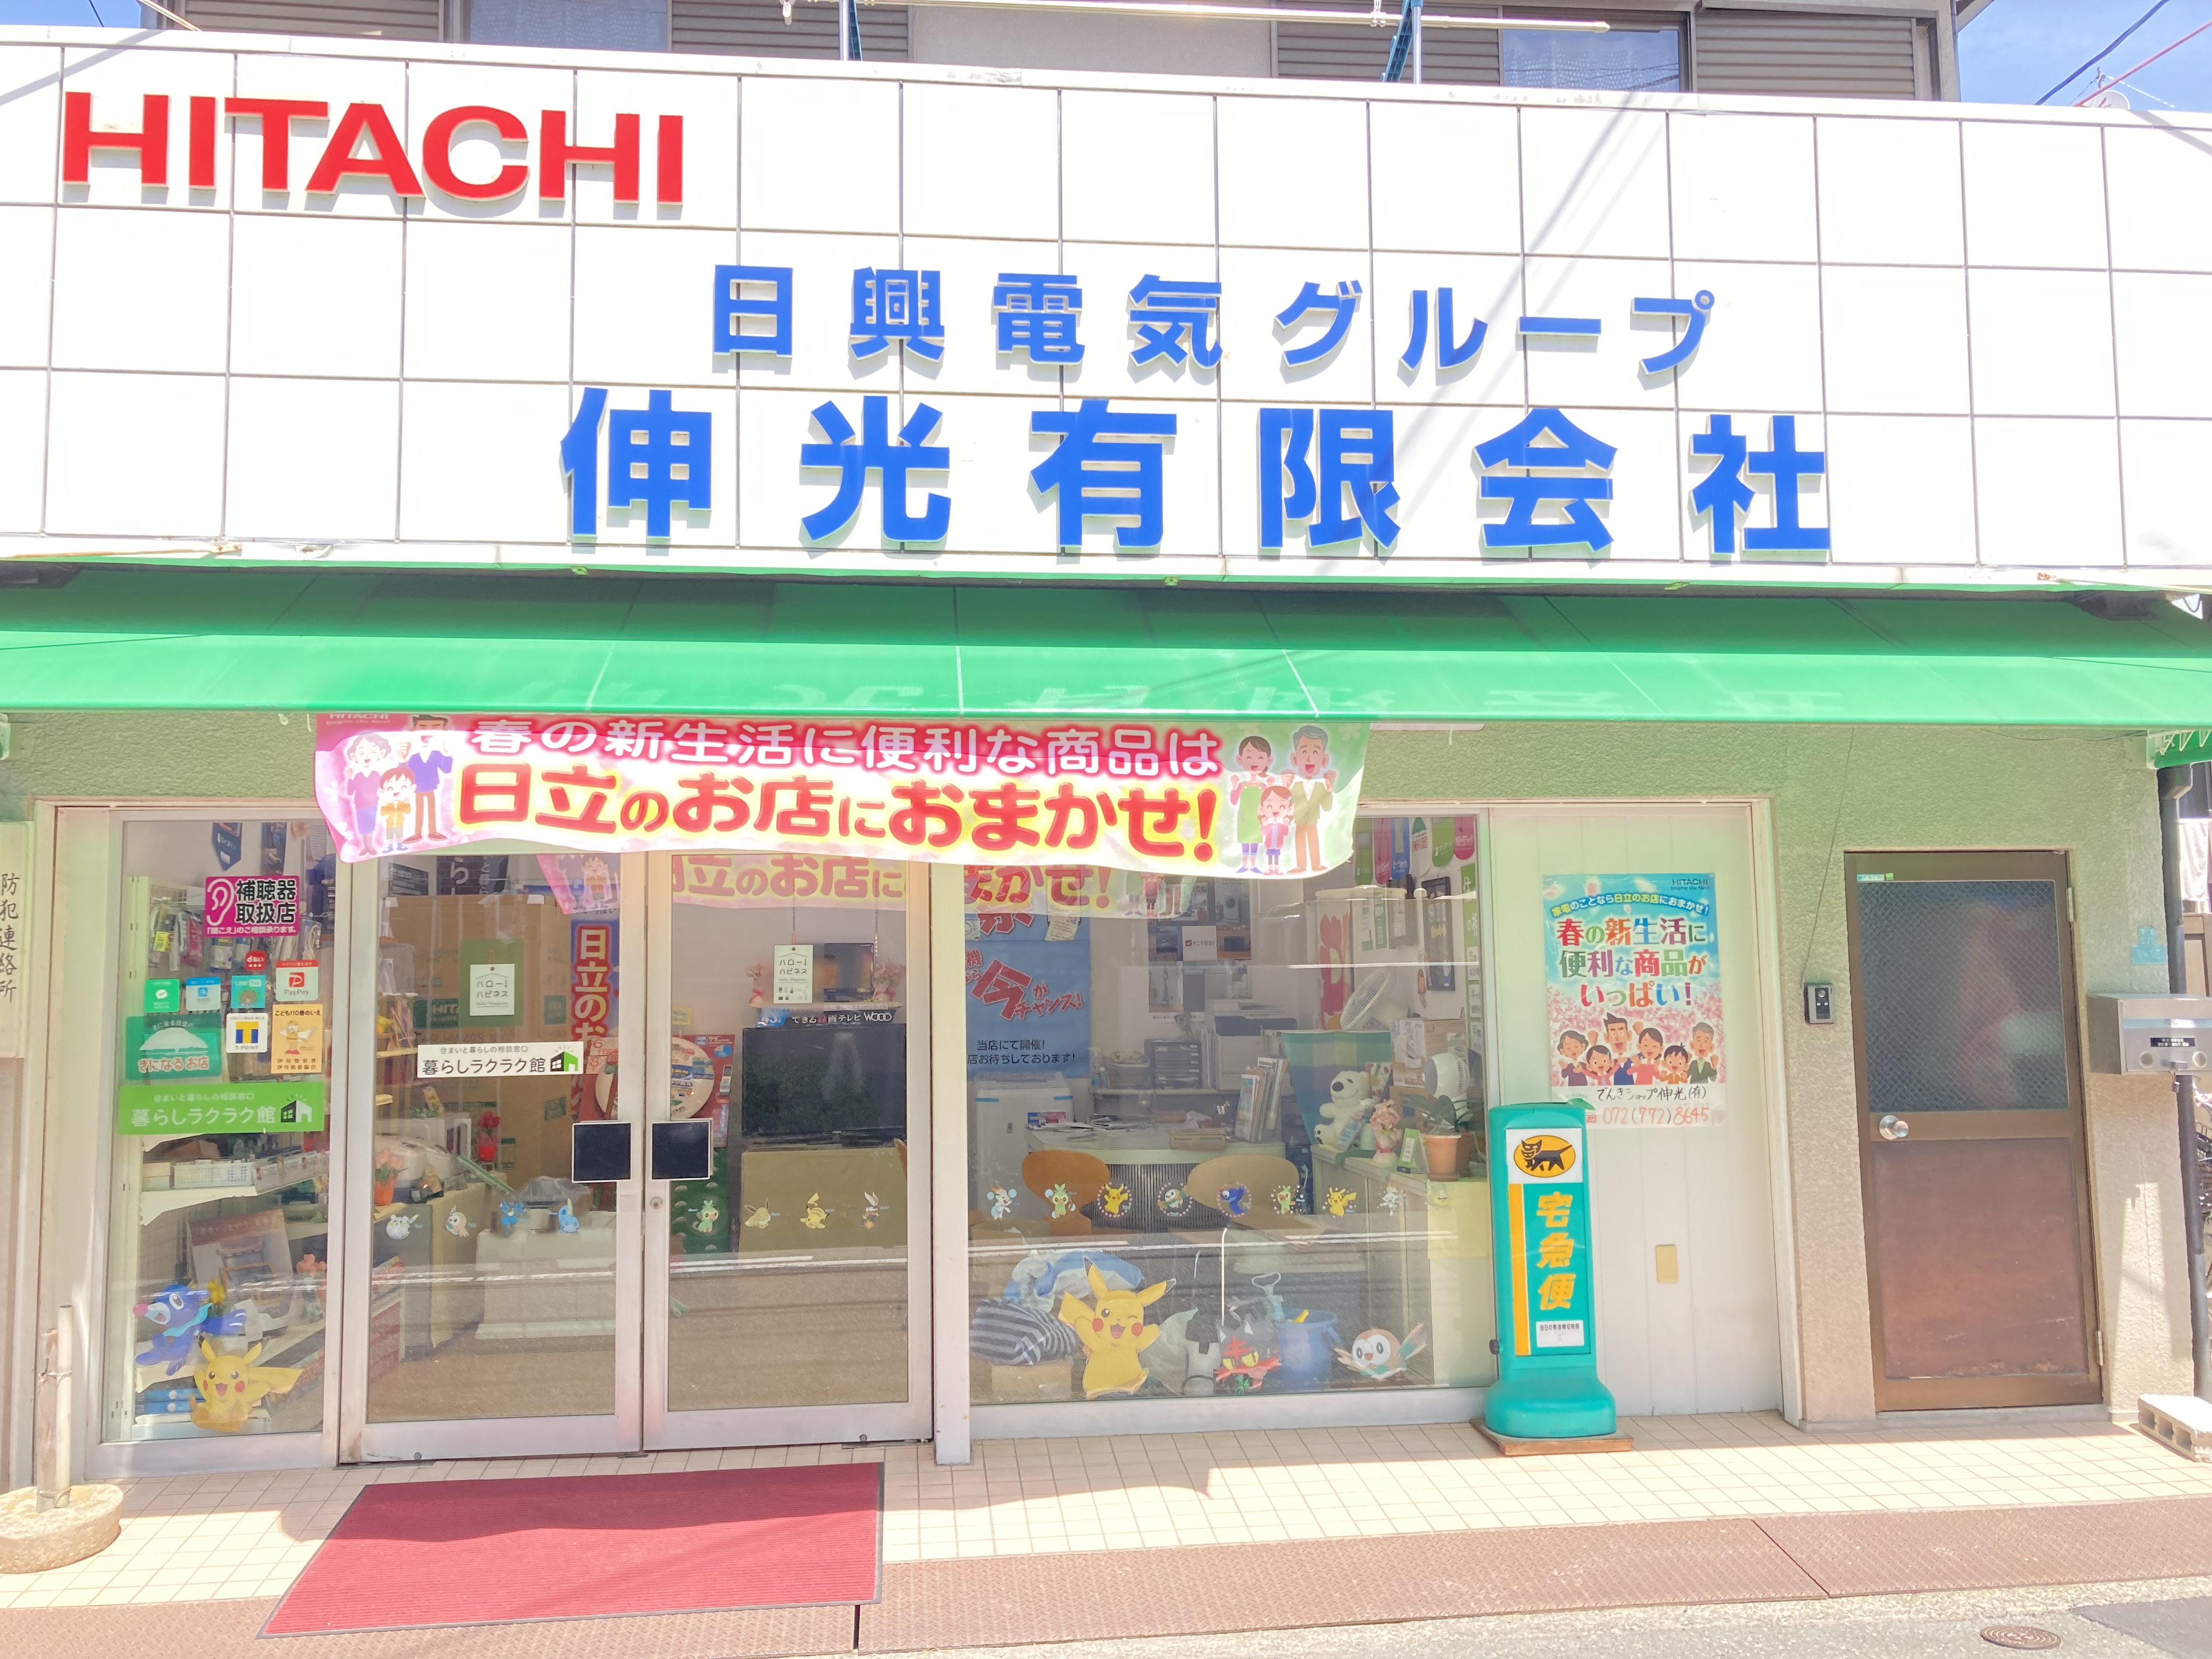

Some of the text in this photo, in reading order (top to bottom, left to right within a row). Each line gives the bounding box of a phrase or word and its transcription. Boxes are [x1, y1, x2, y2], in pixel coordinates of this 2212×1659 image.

[63, 92, 683, 205] HITACHI
[714, 264, 1715, 377] 日興電気グループ
[560, 387, 1831, 554] 伸光有限会社
[472, 719, 1219, 776] 春の新生活に便利な商品は
[459, 763, 1217, 862] 日立のお店におまかせ!
[235, 879, 296, 901] 補聴器
[235, 902, 296, 924] 取扱店
[1551, 893, 1709, 917] 家電のことなら日立のお店におまかせ!
[1556, 917, 1706, 946] 春の新生活に
[1559, 948, 1707, 979] 便利な商品が
[476, 979, 508, 988] ハロー!
[476, 990, 509, 998] ハピネス
[1580, 980, 1692, 1008] いっぱい!
[440, 1045, 528, 1055] 住まいと暮らしの相談窓口
[977, 1040, 1045, 1051] 当店にて開催!
[138, 1055, 210, 1073] きになるお店
[422, 1057, 546, 1076] 暮らしラクラク館
[967, 1053, 1075, 1065] 店お待ちしております!
[153, 1092, 255, 1103] 住まいと暮らしの相談窓口
[131, 1105, 276, 1127] 暮らしラクラク館
[1602, 1107, 1710, 1125] 072(772)8645
[1536, 1191, 1576, 1310] 宅急便
